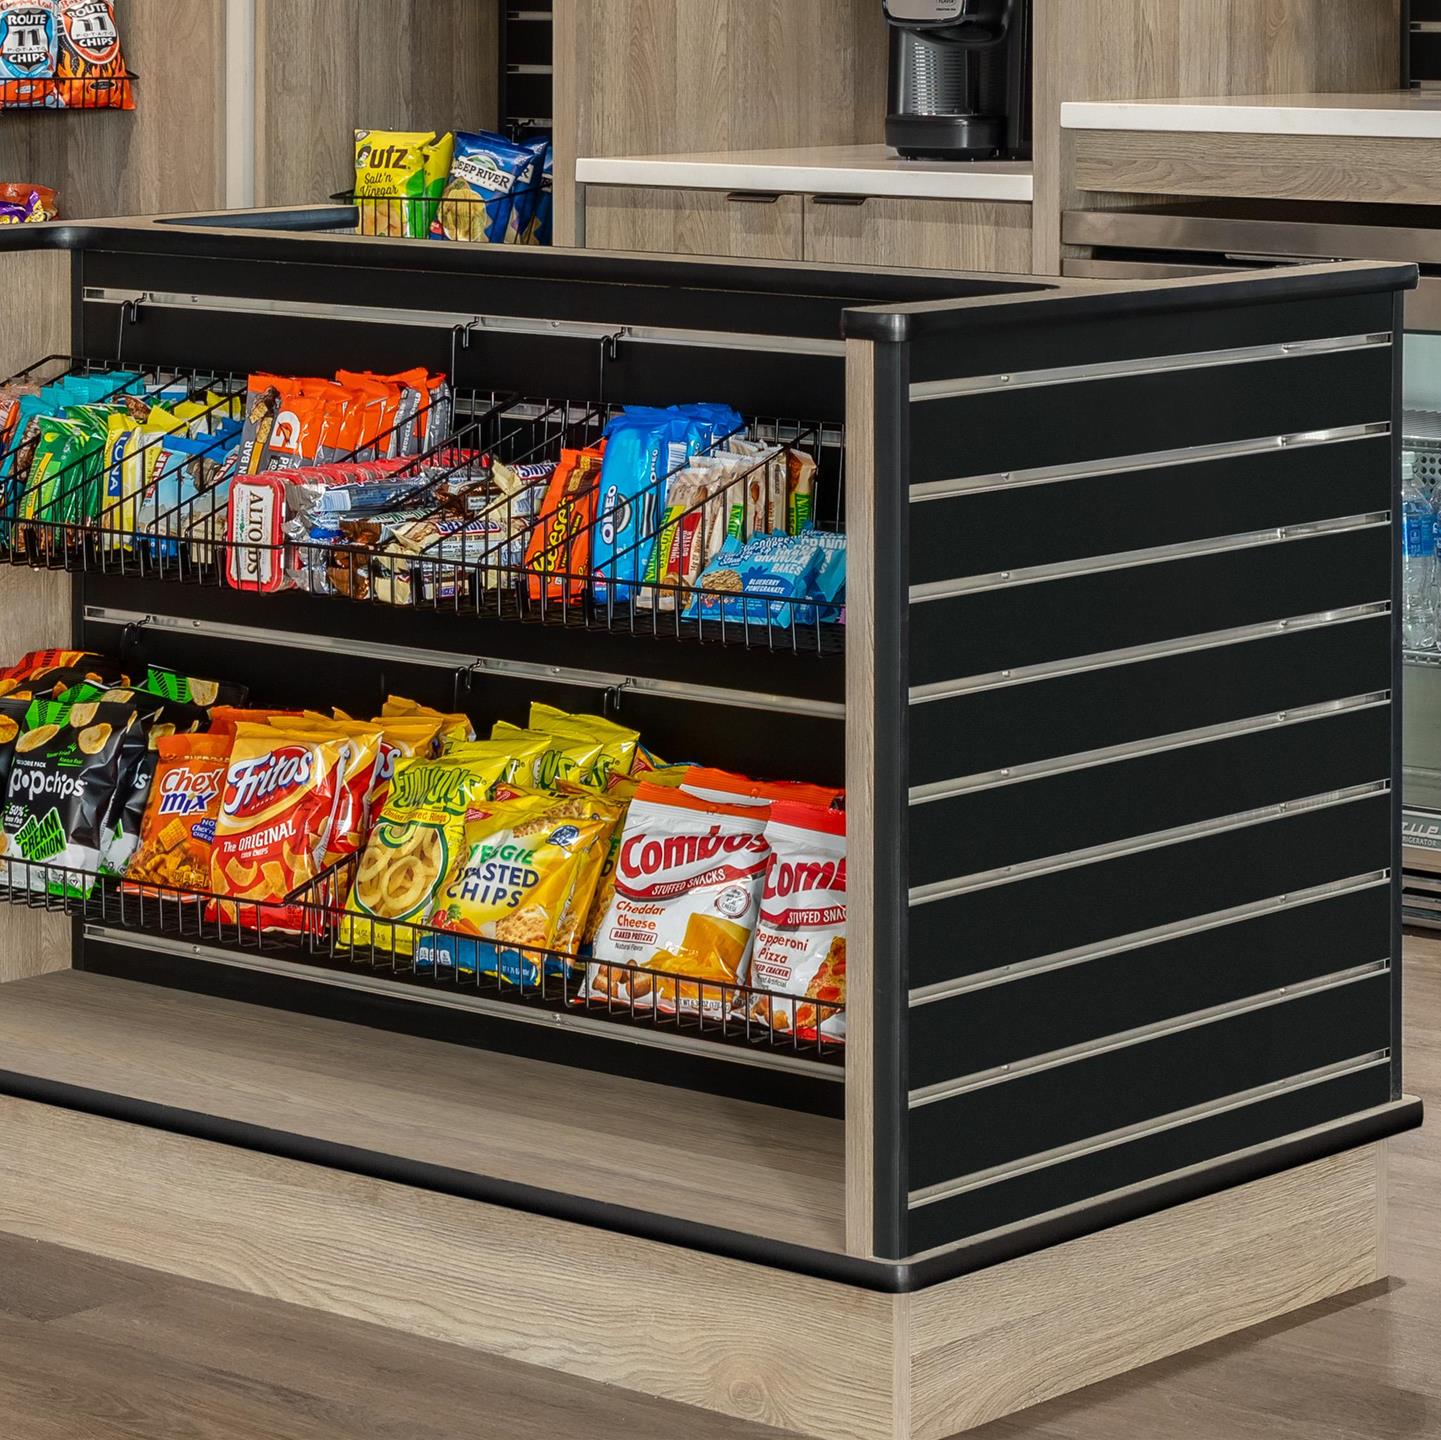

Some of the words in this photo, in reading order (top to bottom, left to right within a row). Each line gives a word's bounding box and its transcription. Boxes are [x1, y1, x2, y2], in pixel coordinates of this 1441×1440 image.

[67, 3, 107, 17] ROUTE
[7, 15, 46, 25] ROUTE
[78, 16, 107, 31] 11
[13, 29, 40, 46] 11
[79, 37, 113, 47] CHIPS
[9, 53, 45, 62] CHIPS
[365, 172, 382, 184] Salt
[477, 166, 510, 187] RIVER
[361, 185, 398, 197] Vinegar
[108, 435, 128, 491] LUNA
[602, 485, 617, 544] OREO
[247, 491, 264, 574] ALTOIDS
[744, 586, 785, 594] POMEGRANATE
[749, 578, 780, 586] BLUEBERRY
[9, 767, 87, 800] popchips
[160, 768, 224, 794] Chex
[224, 752, 312, 814] Fritos
[15, 822, 37, 844] SOUR
[21, 810, 59, 858] CREAM
[224, 842, 236, 853] The
[239, 820, 296, 851] ORIGINAL
[253, 848, 269, 857] CHIPS
[620, 825, 770, 879] Combos
[652, 881, 686, 895] STUFFED
[688, 869, 726, 887] SNACKS
[447, 881, 522, 908] CHIPS
[616, 901, 665, 915] Cheddar
[788, 909, 821, 923] STUFFED
[617, 915, 656, 930] Cheese
[614, 931, 630, 941] BAKED
[630, 932, 654, 942] PRETZEL
[756, 929, 808, 952] Pepperoni
[758, 948, 788, 964] Pizza
[766, 966, 789, 978] CRACKER
